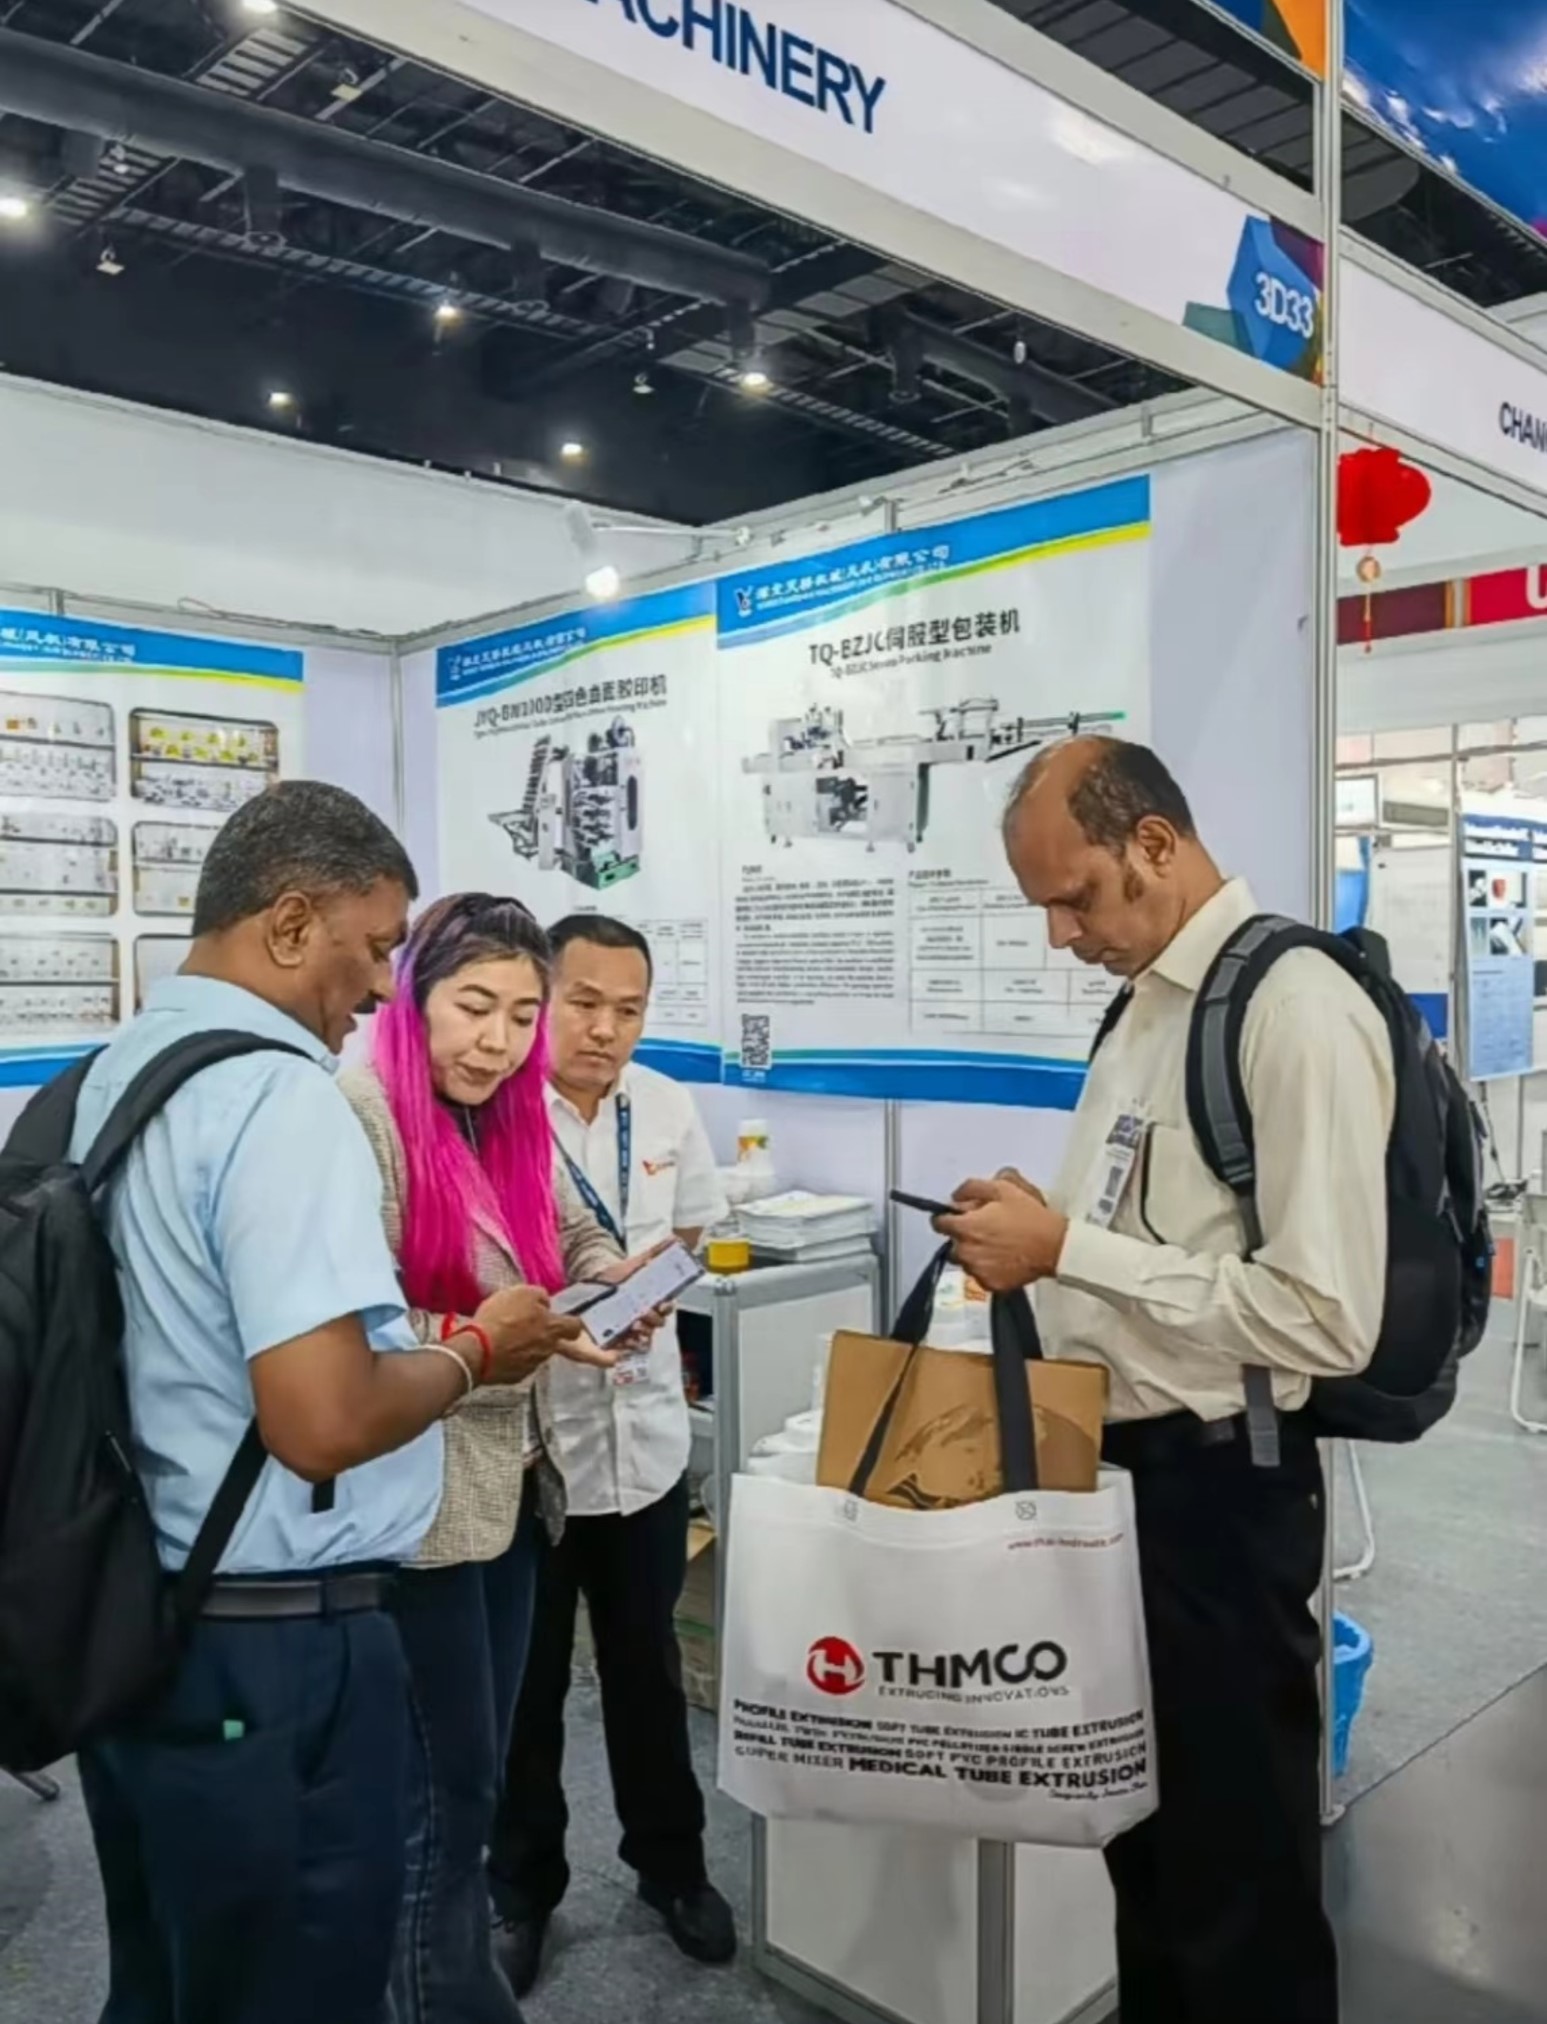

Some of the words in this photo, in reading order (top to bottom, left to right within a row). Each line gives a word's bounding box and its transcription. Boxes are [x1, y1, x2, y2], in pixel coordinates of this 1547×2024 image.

[1255, 272, 1314, 338] 3D33
[872, 1641, 1067, 1688] THMCO
[1073, 1709, 1144, 1736] EXTRUSION
[950, 1752, 982, 1766] PVC
[986, 1755, 1057, 1769] PROFILE
[1061, 1741, 1146, 1769] EXTRUSION
[849, 1757, 948, 1780] MEDICAL
[954, 1766, 1013, 1785] TUBE
[1018, 1757, 1147, 1789] EXTRUSION
